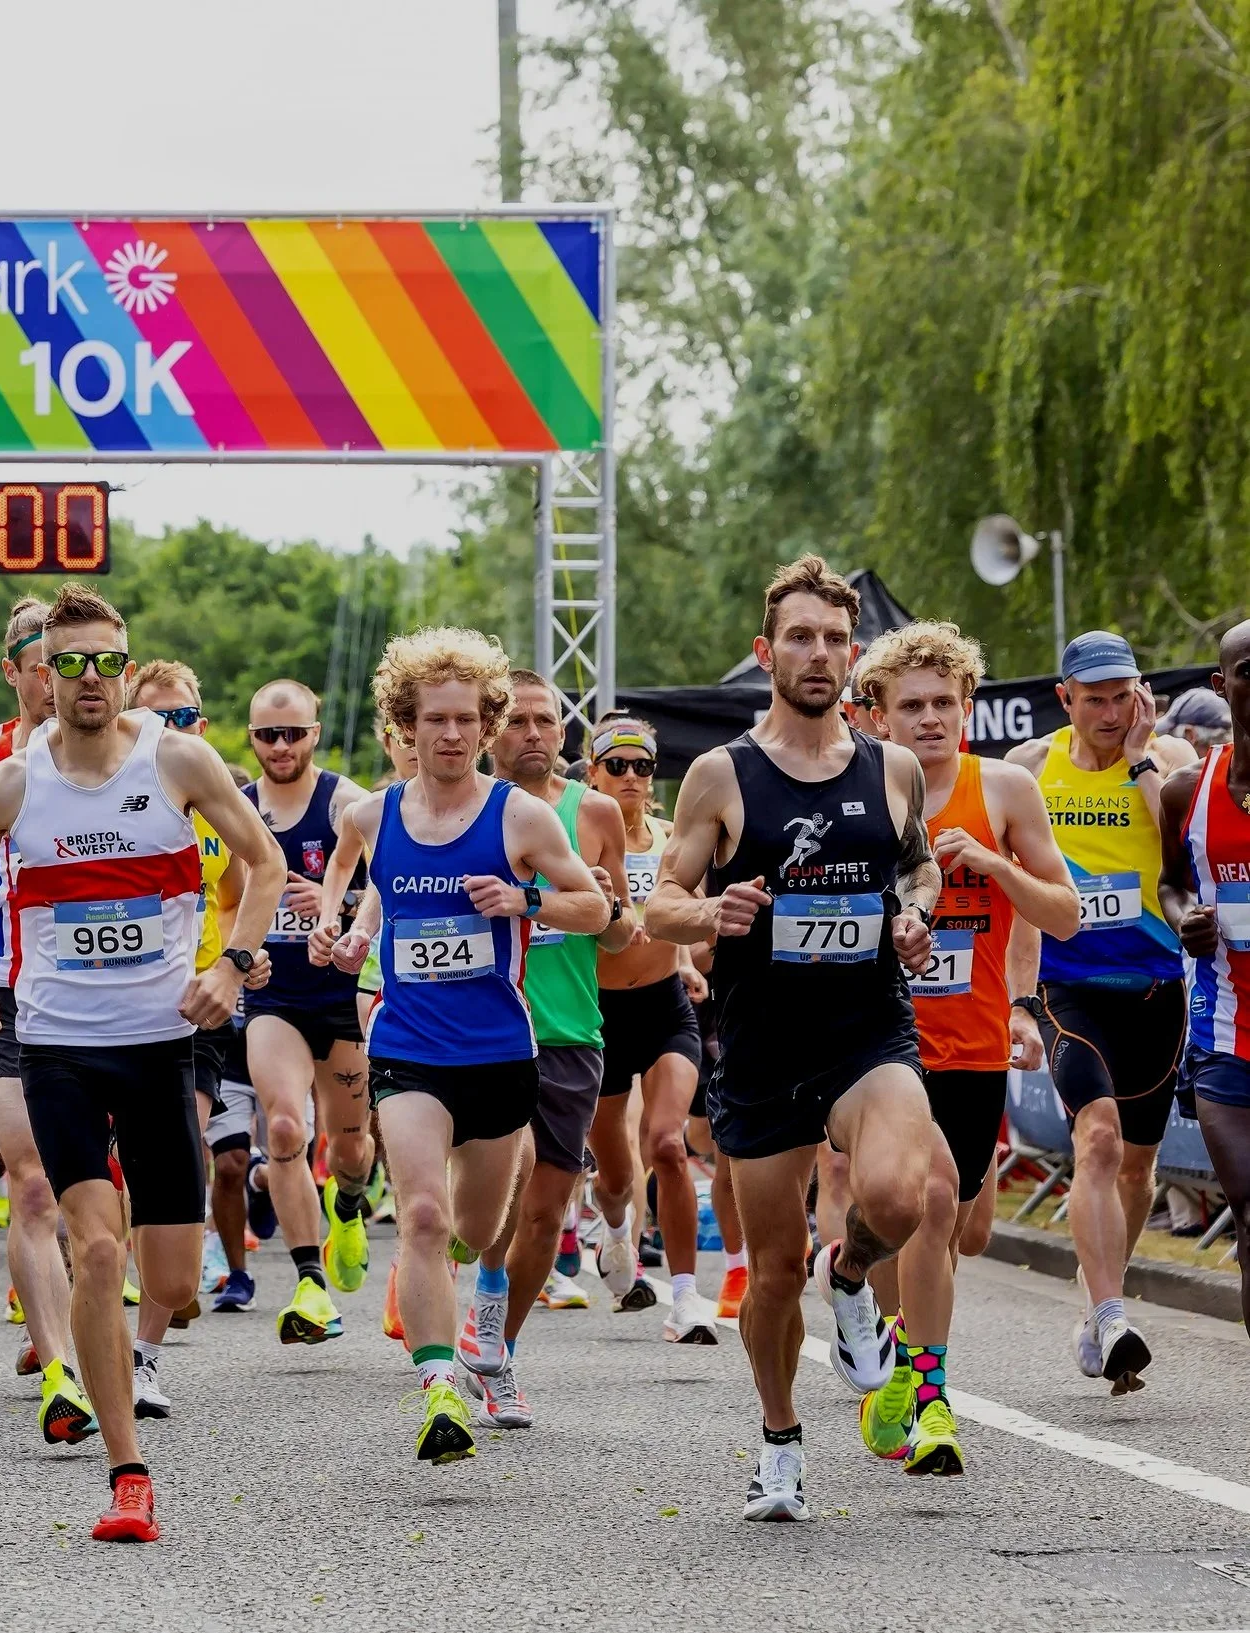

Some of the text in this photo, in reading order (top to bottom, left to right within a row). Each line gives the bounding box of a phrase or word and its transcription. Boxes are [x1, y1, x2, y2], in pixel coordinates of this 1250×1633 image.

[19, 341, 196, 418] 10K
[965, 697, 1033, 741] ING
[1065, 795, 1130, 809] ALBANS
[66, 831, 123, 846] BRISTOL
[77, 843, 117, 856] WEST
[118, 841, 136, 852] AC
[789, 862, 869, 877] RUNFAST
[1216, 863, 1250, 882] REA
[392, 876, 464, 894] CARDIF
[787, 874, 871, 888] COACHING
[935, 895, 991, 909] ESS
[275, 912, 320, 931] 128
[73, 924, 143, 955] 969
[796, 920, 860, 949] 770
[410, 939, 473, 969] 324
[904, 954, 956, 981] 21
